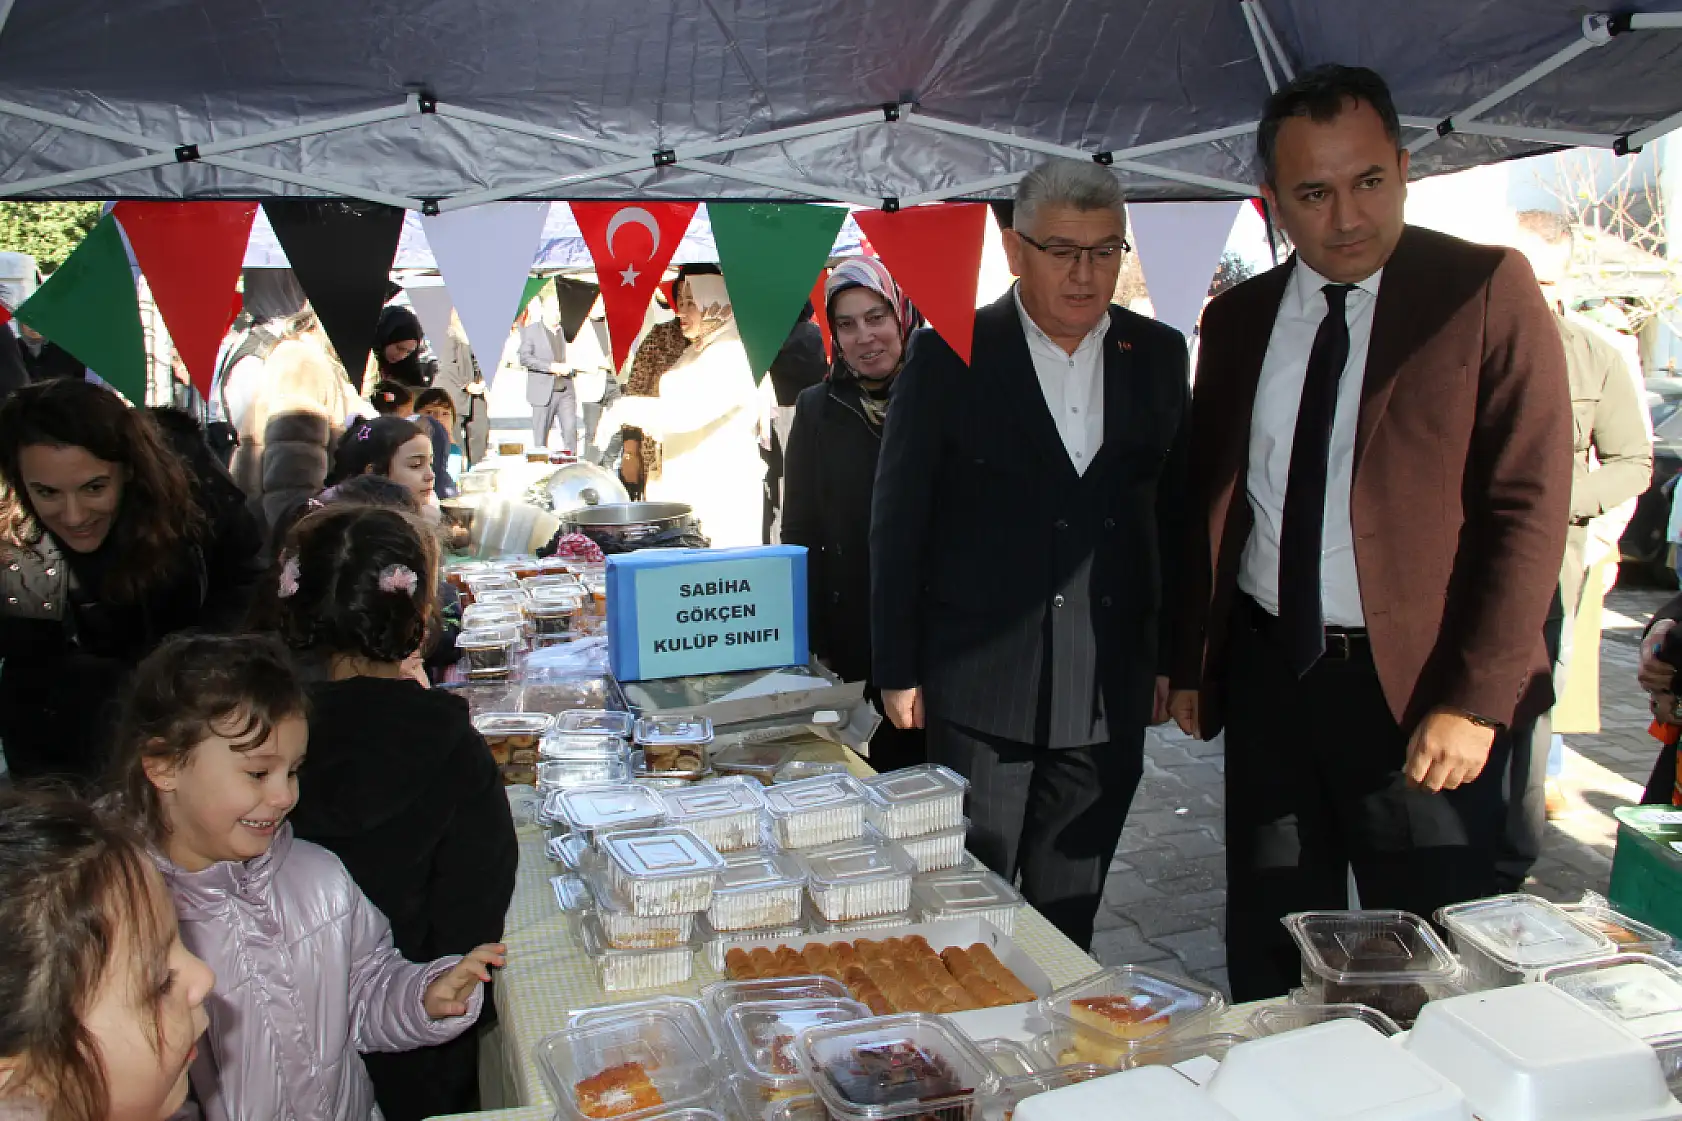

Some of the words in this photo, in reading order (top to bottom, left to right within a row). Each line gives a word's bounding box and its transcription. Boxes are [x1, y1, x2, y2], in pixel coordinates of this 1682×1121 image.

[679, 577, 751, 598] SABİHA
[676, 603, 756, 624] GÖKÇEN
[653, 633, 718, 653] KULÜP
[725, 628, 779, 646] SINIFI
